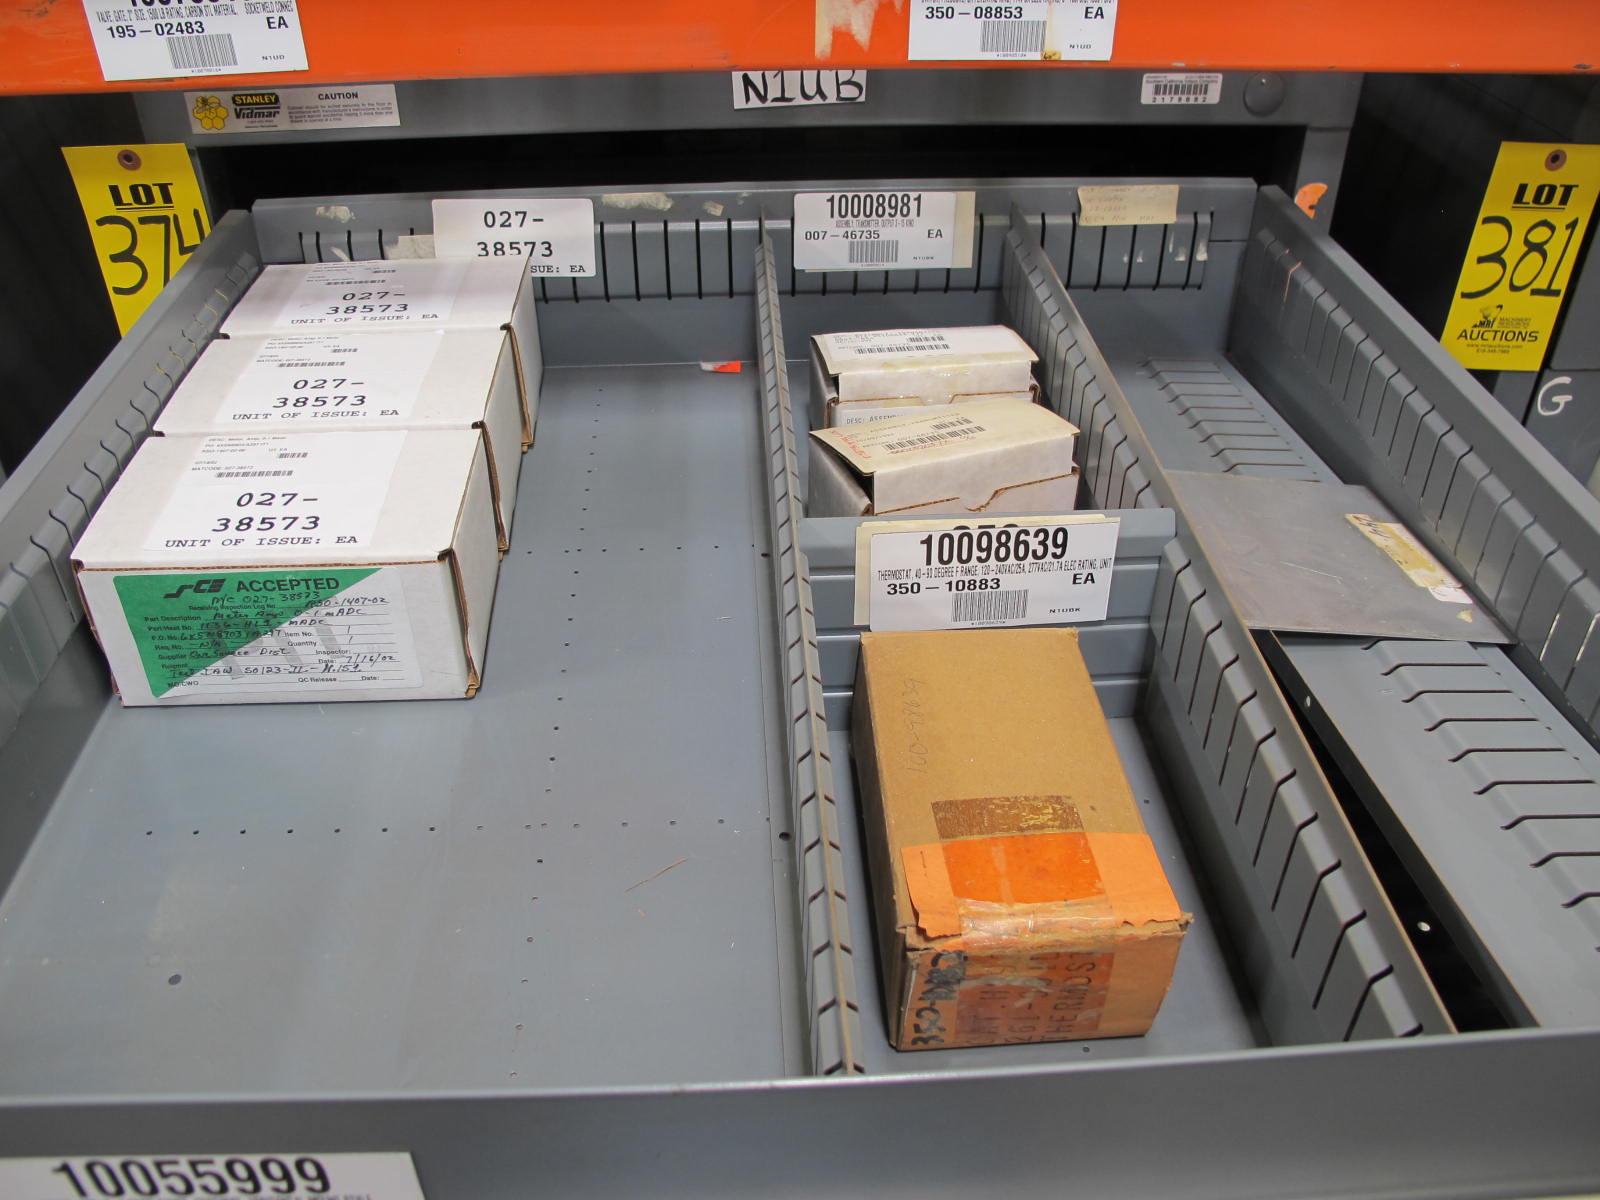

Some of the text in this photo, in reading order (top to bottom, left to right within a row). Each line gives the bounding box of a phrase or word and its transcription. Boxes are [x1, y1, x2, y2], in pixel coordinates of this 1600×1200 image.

[1084, 6, 1105, 20] EA
[266, 16, 289, 30] EA
[234, 94, 276, 104] STANLEY
[318, 92, 359, 101] CAUTION
[234, 106, 280, 119] Vidmar
[108, 182, 174, 207] LOT
[1512, 183, 1579, 206] LOT
[826, 193, 923, 219] 10008981
[483, 210, 544, 229] 027-
[927, 228, 943, 239] EA
[95, 208, 206, 296] 374
[476, 241, 553, 258] 38573
[1460, 215, 1580, 299] 381
[530, 264, 586, 274] SUE: EA
[342, 291, 406, 301] 027-
[326, 303, 409, 315] 38573
[290, 318, 327, 326] UNIT
[1456, 329, 1540, 343] AUCTIONS
[292, 378, 365, 390] 027-
[272, 395, 367, 409] 38573
[1537, 376, 1573, 417] G
[232, 413, 272, 421] UNIT
[312, 411, 367, 419] ISSUE:
[379, 409, 400, 417] EA
[236, 493, 318, 508] 027-
[211, 515, 321, 533] 38573
[165, 536, 358, 548] UNIT OF ISSUE: EA
[919, 526, 1069, 567] 10098639
[1100, 558, 1112, 569] UNIT
[236, 577, 340, 592] ACCEPTED
[1071, 572, 1096, 585] EA
[160, 613, 202, 622] Description
[315, 648, 352, 656] Inspector:
[51, 1157, 332, 1198] 10055999
